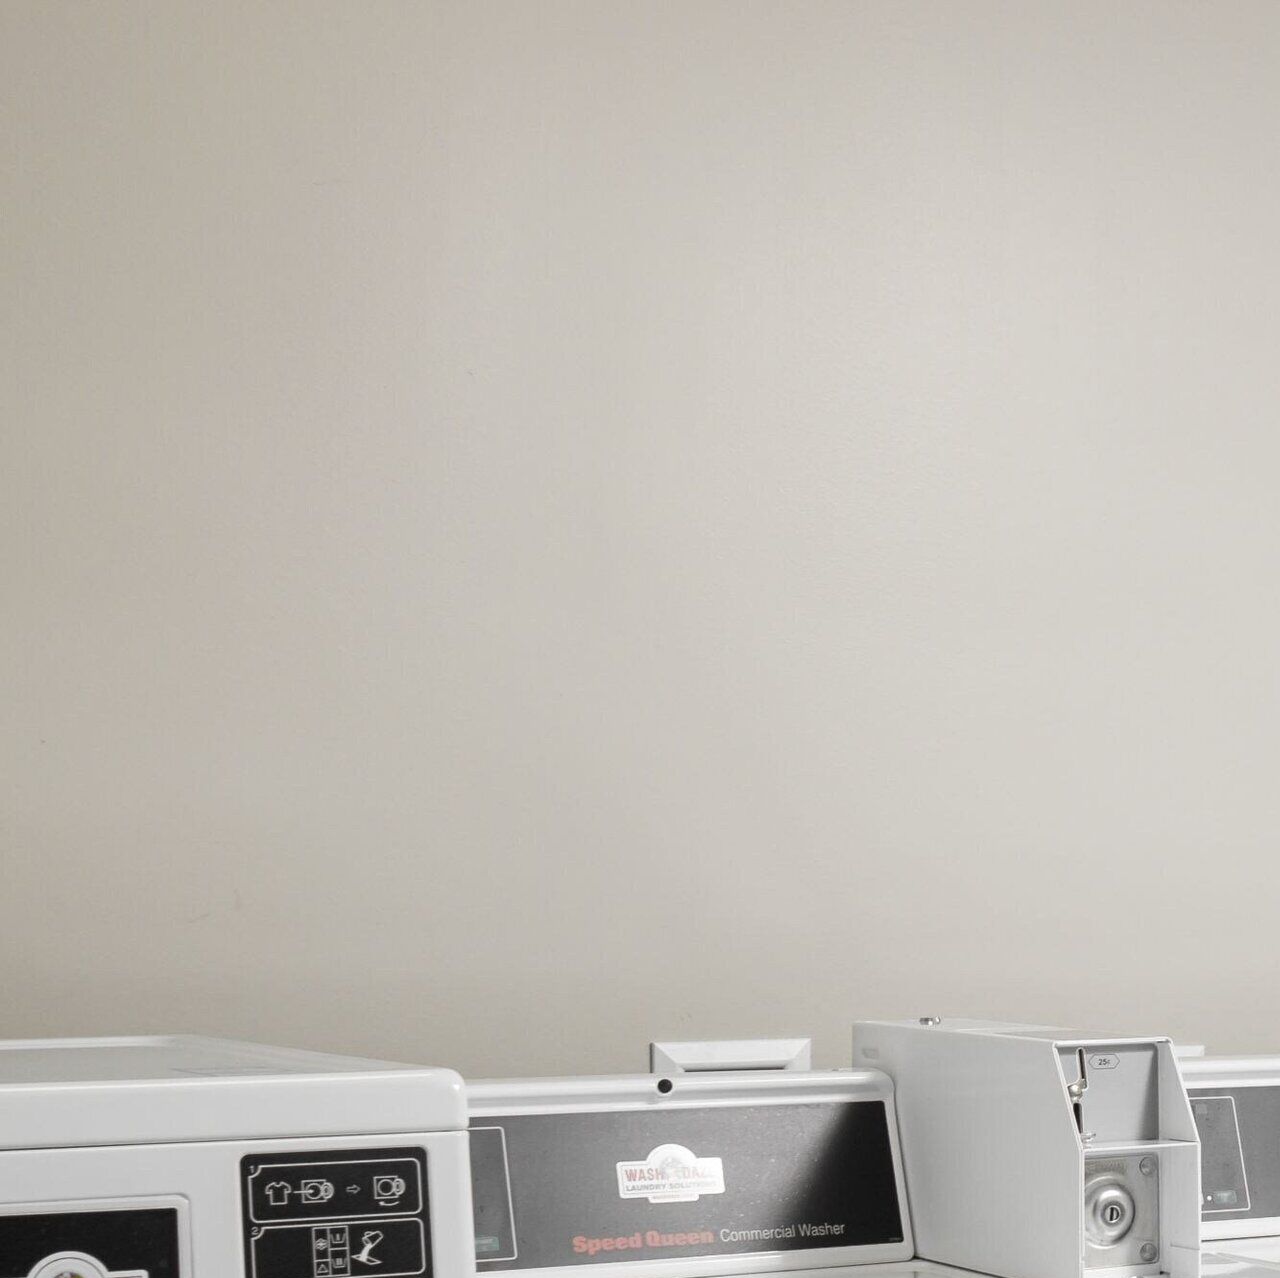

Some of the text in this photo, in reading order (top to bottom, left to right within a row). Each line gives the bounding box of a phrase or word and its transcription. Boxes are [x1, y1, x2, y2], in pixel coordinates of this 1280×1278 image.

[249, 1165, 255, 1173] 1
[624, 1167, 665, 1182] WASH
[625, 1183, 667, 1192] LAUNDRY
[251, 1227, 259, 1236] 2
[572, 1222, 846, 1256] Speed Queen Commercial Washer
